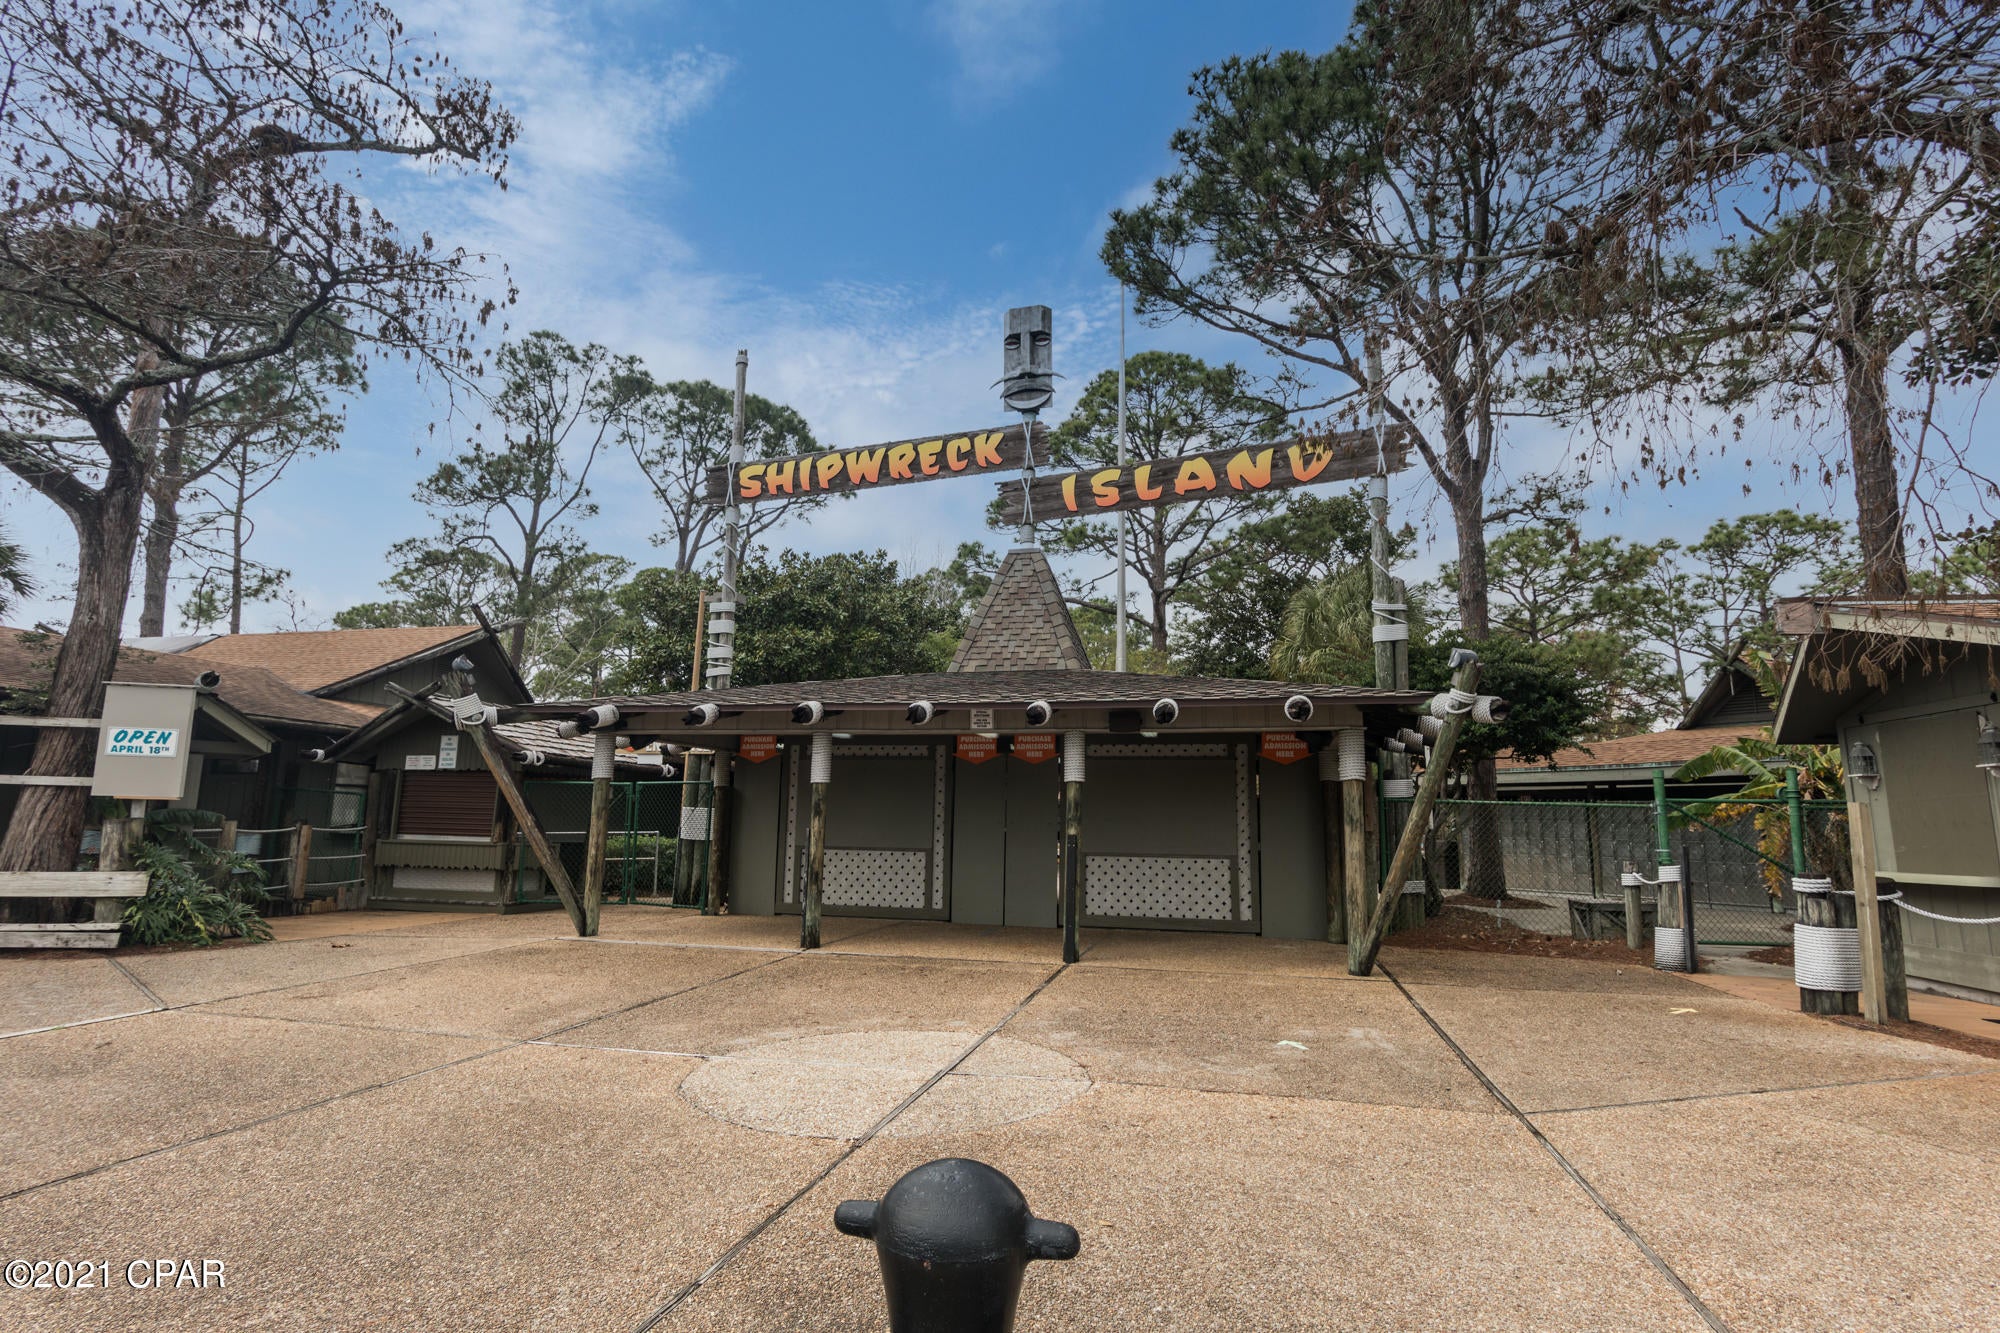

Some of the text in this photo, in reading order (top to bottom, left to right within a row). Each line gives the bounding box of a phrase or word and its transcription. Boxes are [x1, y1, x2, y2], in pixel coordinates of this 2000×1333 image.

[739, 432, 1005, 498] SHIPWRECK
[1061, 441, 1334, 512] ISLAND
[113, 729, 172, 745] OPEN
[111, 745, 170, 754] APRIL 18TH
[1026, 750, 1043, 758] HERE
